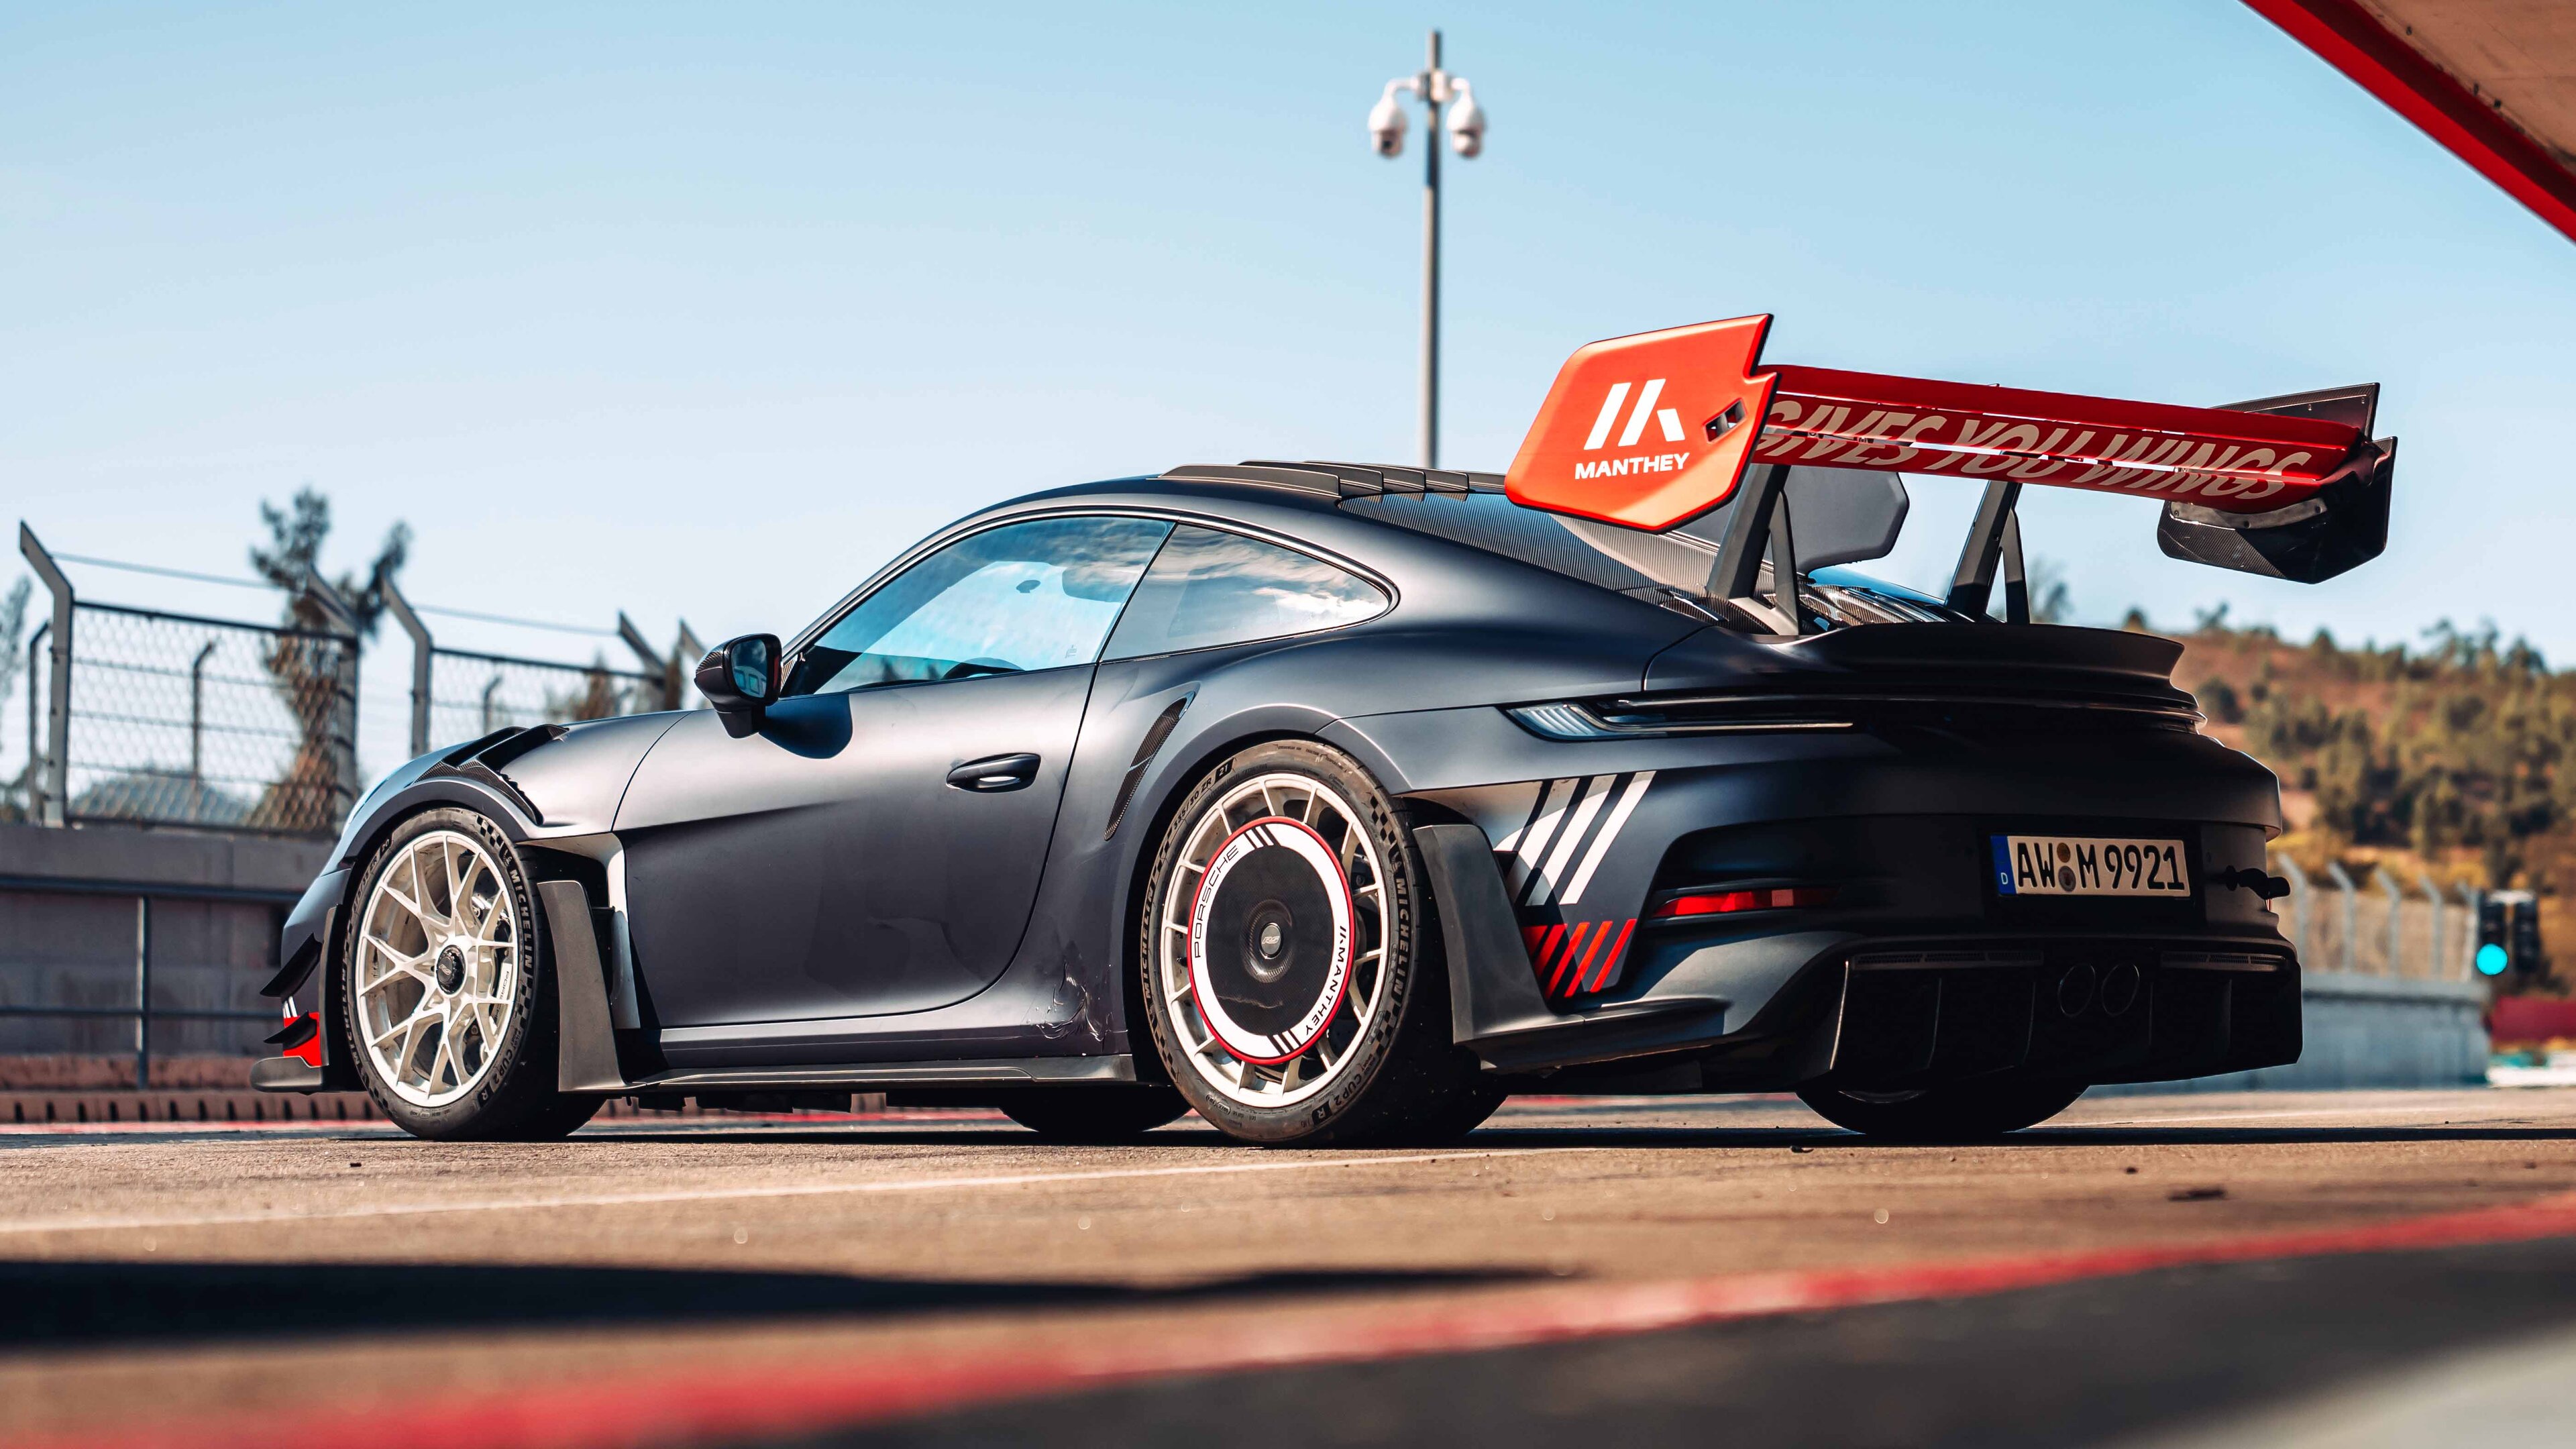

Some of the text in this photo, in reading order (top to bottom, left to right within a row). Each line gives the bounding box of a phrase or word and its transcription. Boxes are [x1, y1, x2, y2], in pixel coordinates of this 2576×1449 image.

[1574, 452, 1690, 480] MANTHEY
[1756, 400, 2312, 500] GIVES YOU WINGS
[1173, 763, 1228, 828] 335/30 ZR 21
[2000, 872, 2008, 885] D
[2017, 843, 2185, 890] AW M 9921
[510, 869, 533, 969] MICHELIN
[1194, 845, 1239, 959] PORSCHE
[1142, 888, 1154, 1000] MICHELIN
[1262, 935, 1281, 945] RS
[1393, 877, 1410, 997] MICHELIN
[1305, 947, 1346, 1036] MANTHEY
[498, 1049, 513, 1077] CUP
[1317, 1073, 1362, 1118] CUP 2 R
